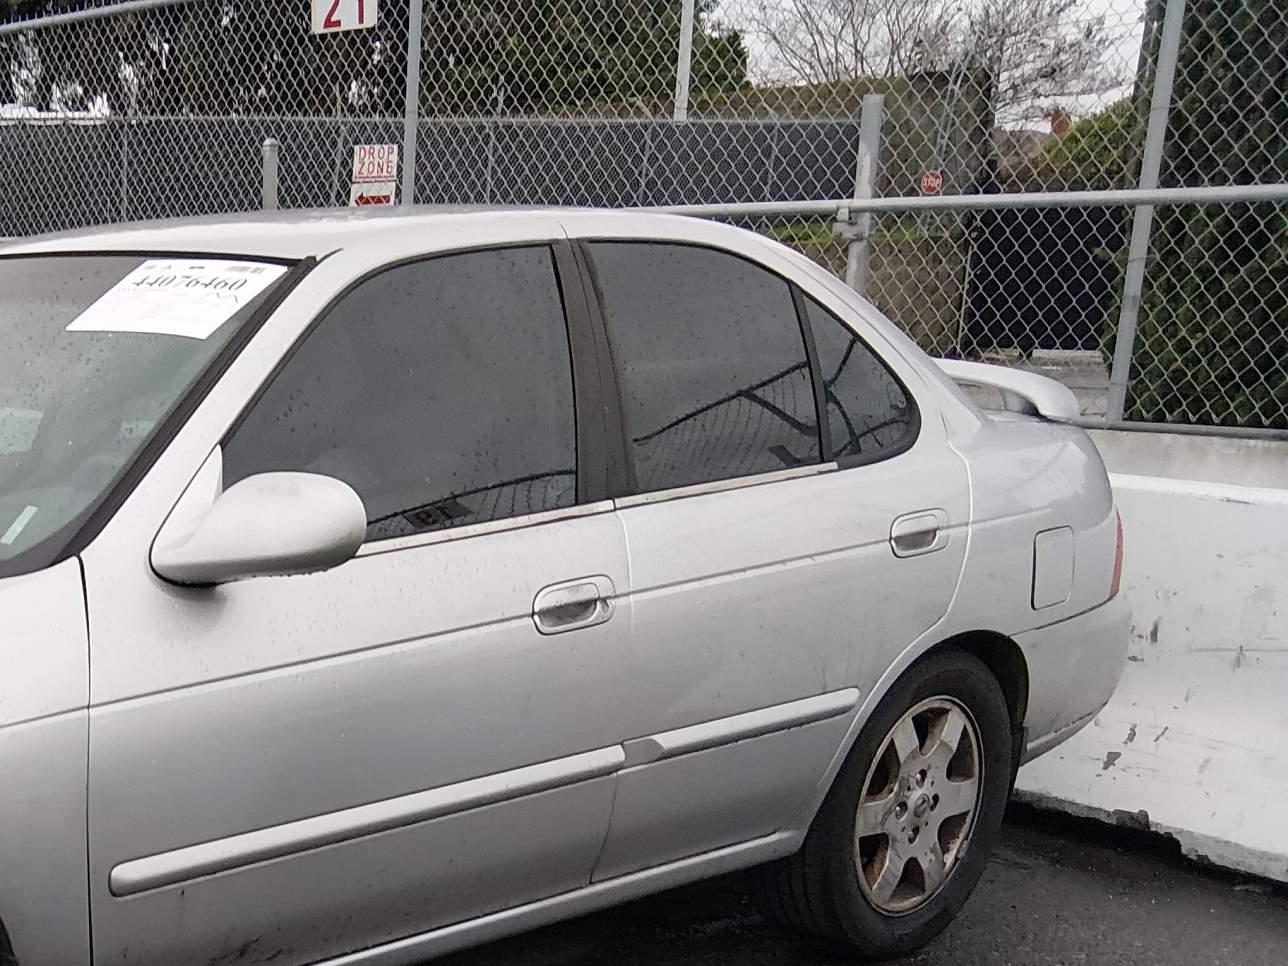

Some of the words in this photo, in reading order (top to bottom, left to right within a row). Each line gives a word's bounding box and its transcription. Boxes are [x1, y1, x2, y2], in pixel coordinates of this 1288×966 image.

[358, 146, 394, 160] DROP
[358, 160, 393, 175] ZONE
[922, 175, 941, 190] STOP
[132, 275, 248, 290] 44076460
